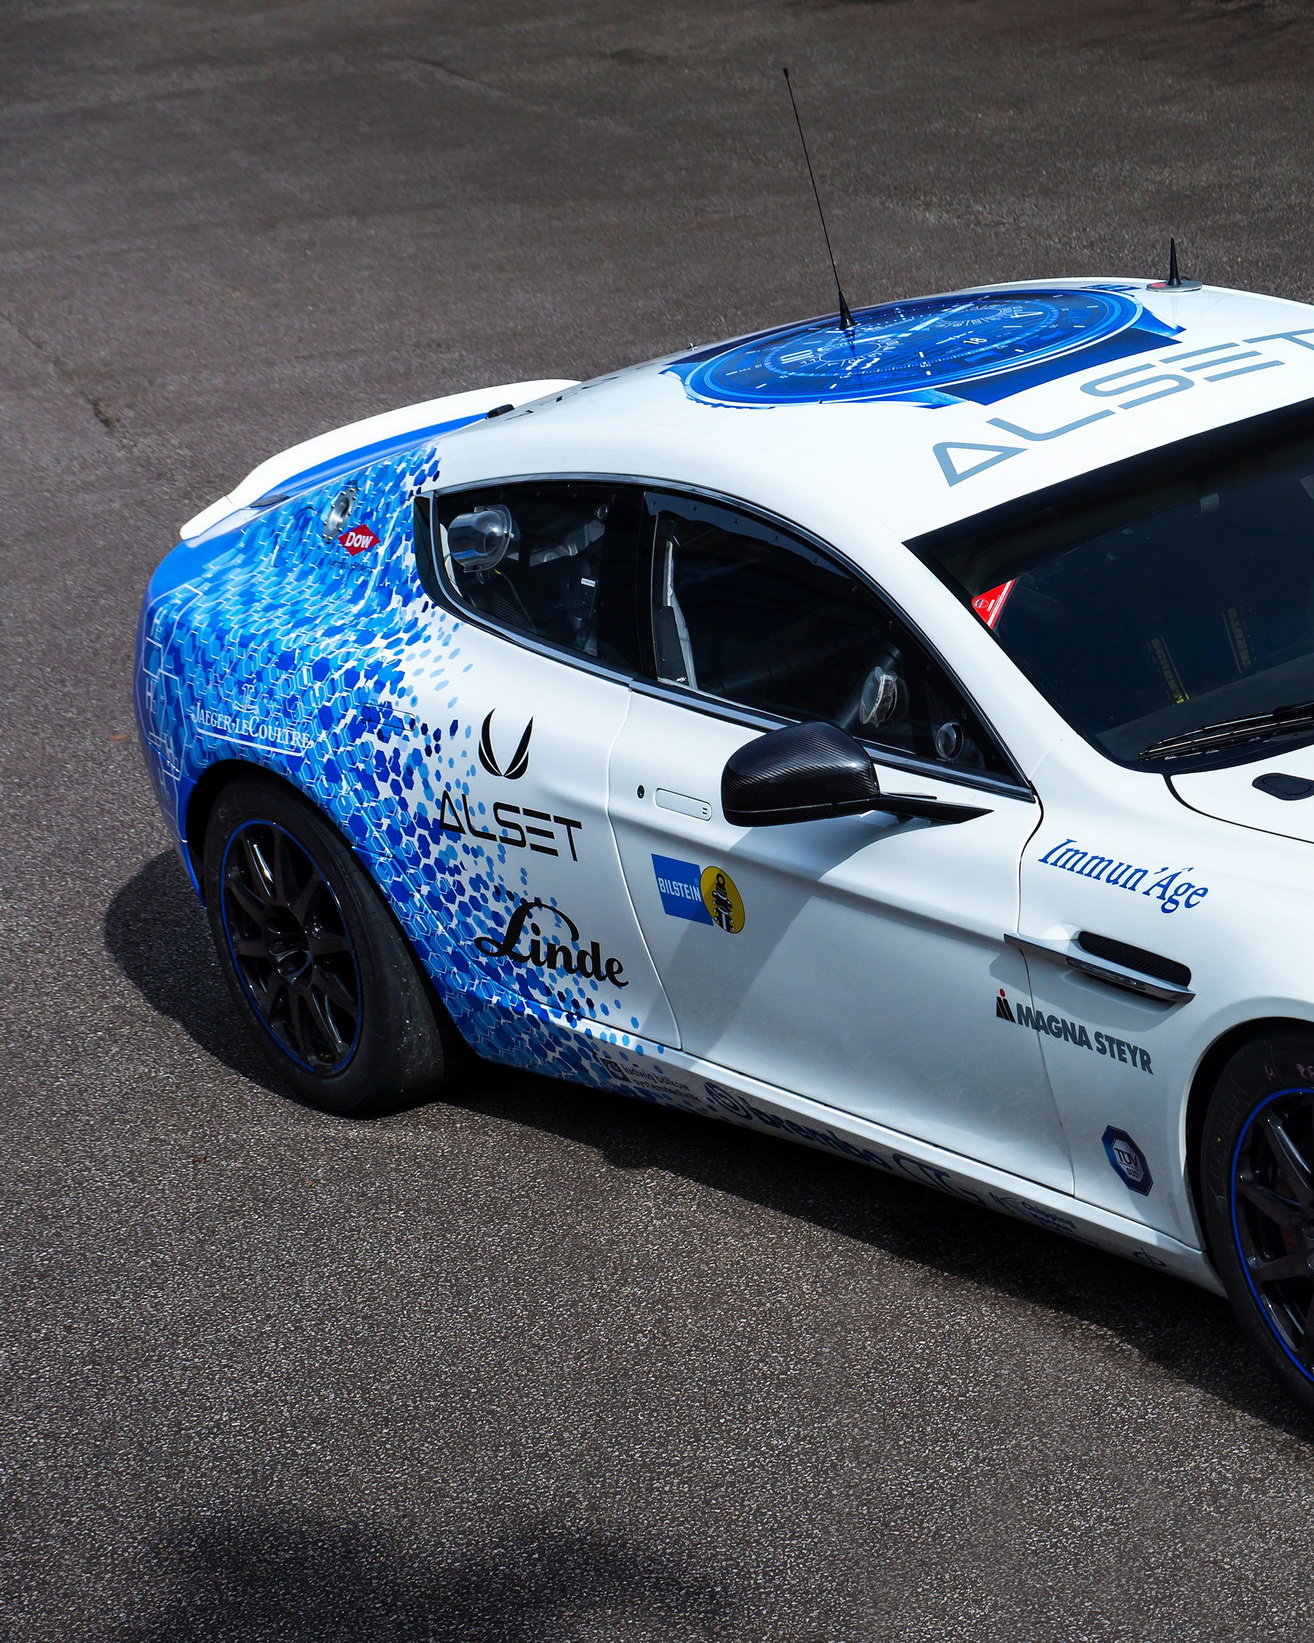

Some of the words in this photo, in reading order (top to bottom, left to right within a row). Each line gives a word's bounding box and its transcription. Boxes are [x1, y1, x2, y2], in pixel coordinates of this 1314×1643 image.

[344, 531, 374, 549] DOW
[439, 789, 583, 862] ALSET
[657, 877, 702, 903] BILSTEIN
[474, 901, 629, 988] Linde
[1016, 1002, 1094, 1052] MAGNA
[1094, 1030, 1154, 1076] STEYR
